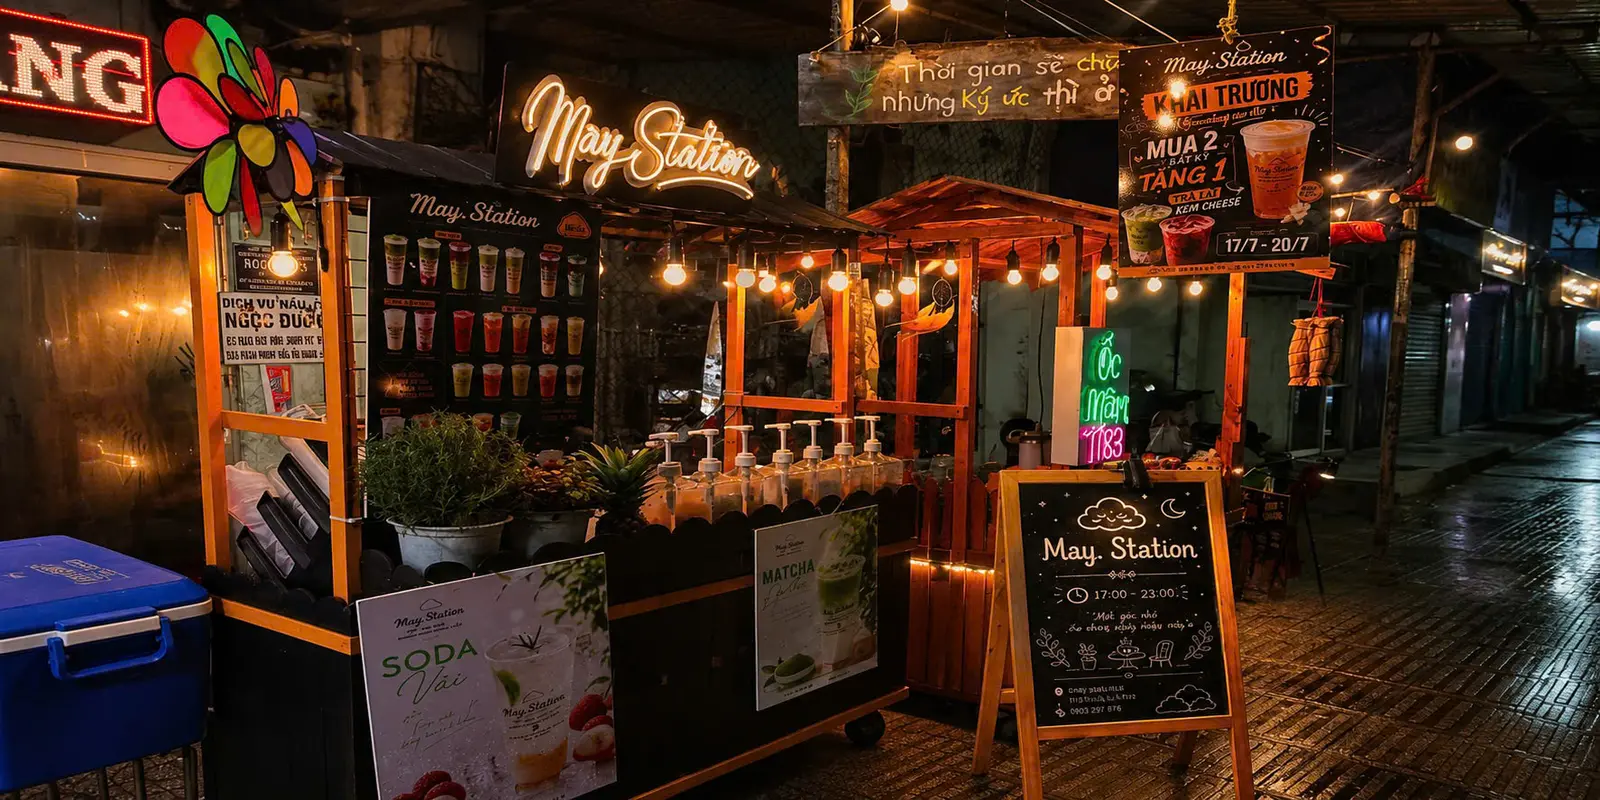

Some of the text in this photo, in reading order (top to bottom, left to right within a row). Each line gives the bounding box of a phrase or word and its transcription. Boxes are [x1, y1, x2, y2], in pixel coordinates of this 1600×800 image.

[0, 33, 146, 113] NG
[900, 62, 955, 84] Thời
[968, 62, 1020, 87] gian
[1035, 54, 1064, 75] sẽ
[1215, 50, 1287, 69] Station
[883, 91, 955, 116] nhưng
[962, 86, 989, 115] Ký
[1003, 86, 1029, 106] ức
[1153, 76, 1298, 115] KHAI TRƯƠNG
[521, 74, 760, 194] May Station
[1147, 130, 1218, 160] MUA 2
[1212, 157, 1226, 182] 1
[469, 201, 540, 229] Station
[1175, 196, 1242, 215] KEM CHEESE
[1225, 238, 1258, 253] 17/7
[1271, 236, 1309, 252] 20/7
[1110, 536, 1198, 560] Station
[762, 558, 815, 585] MATCHA
[1094, 590, 1128, 600] 17:00
[425, 607, 464, 622] Station
[381, 638, 478, 678] SODA
